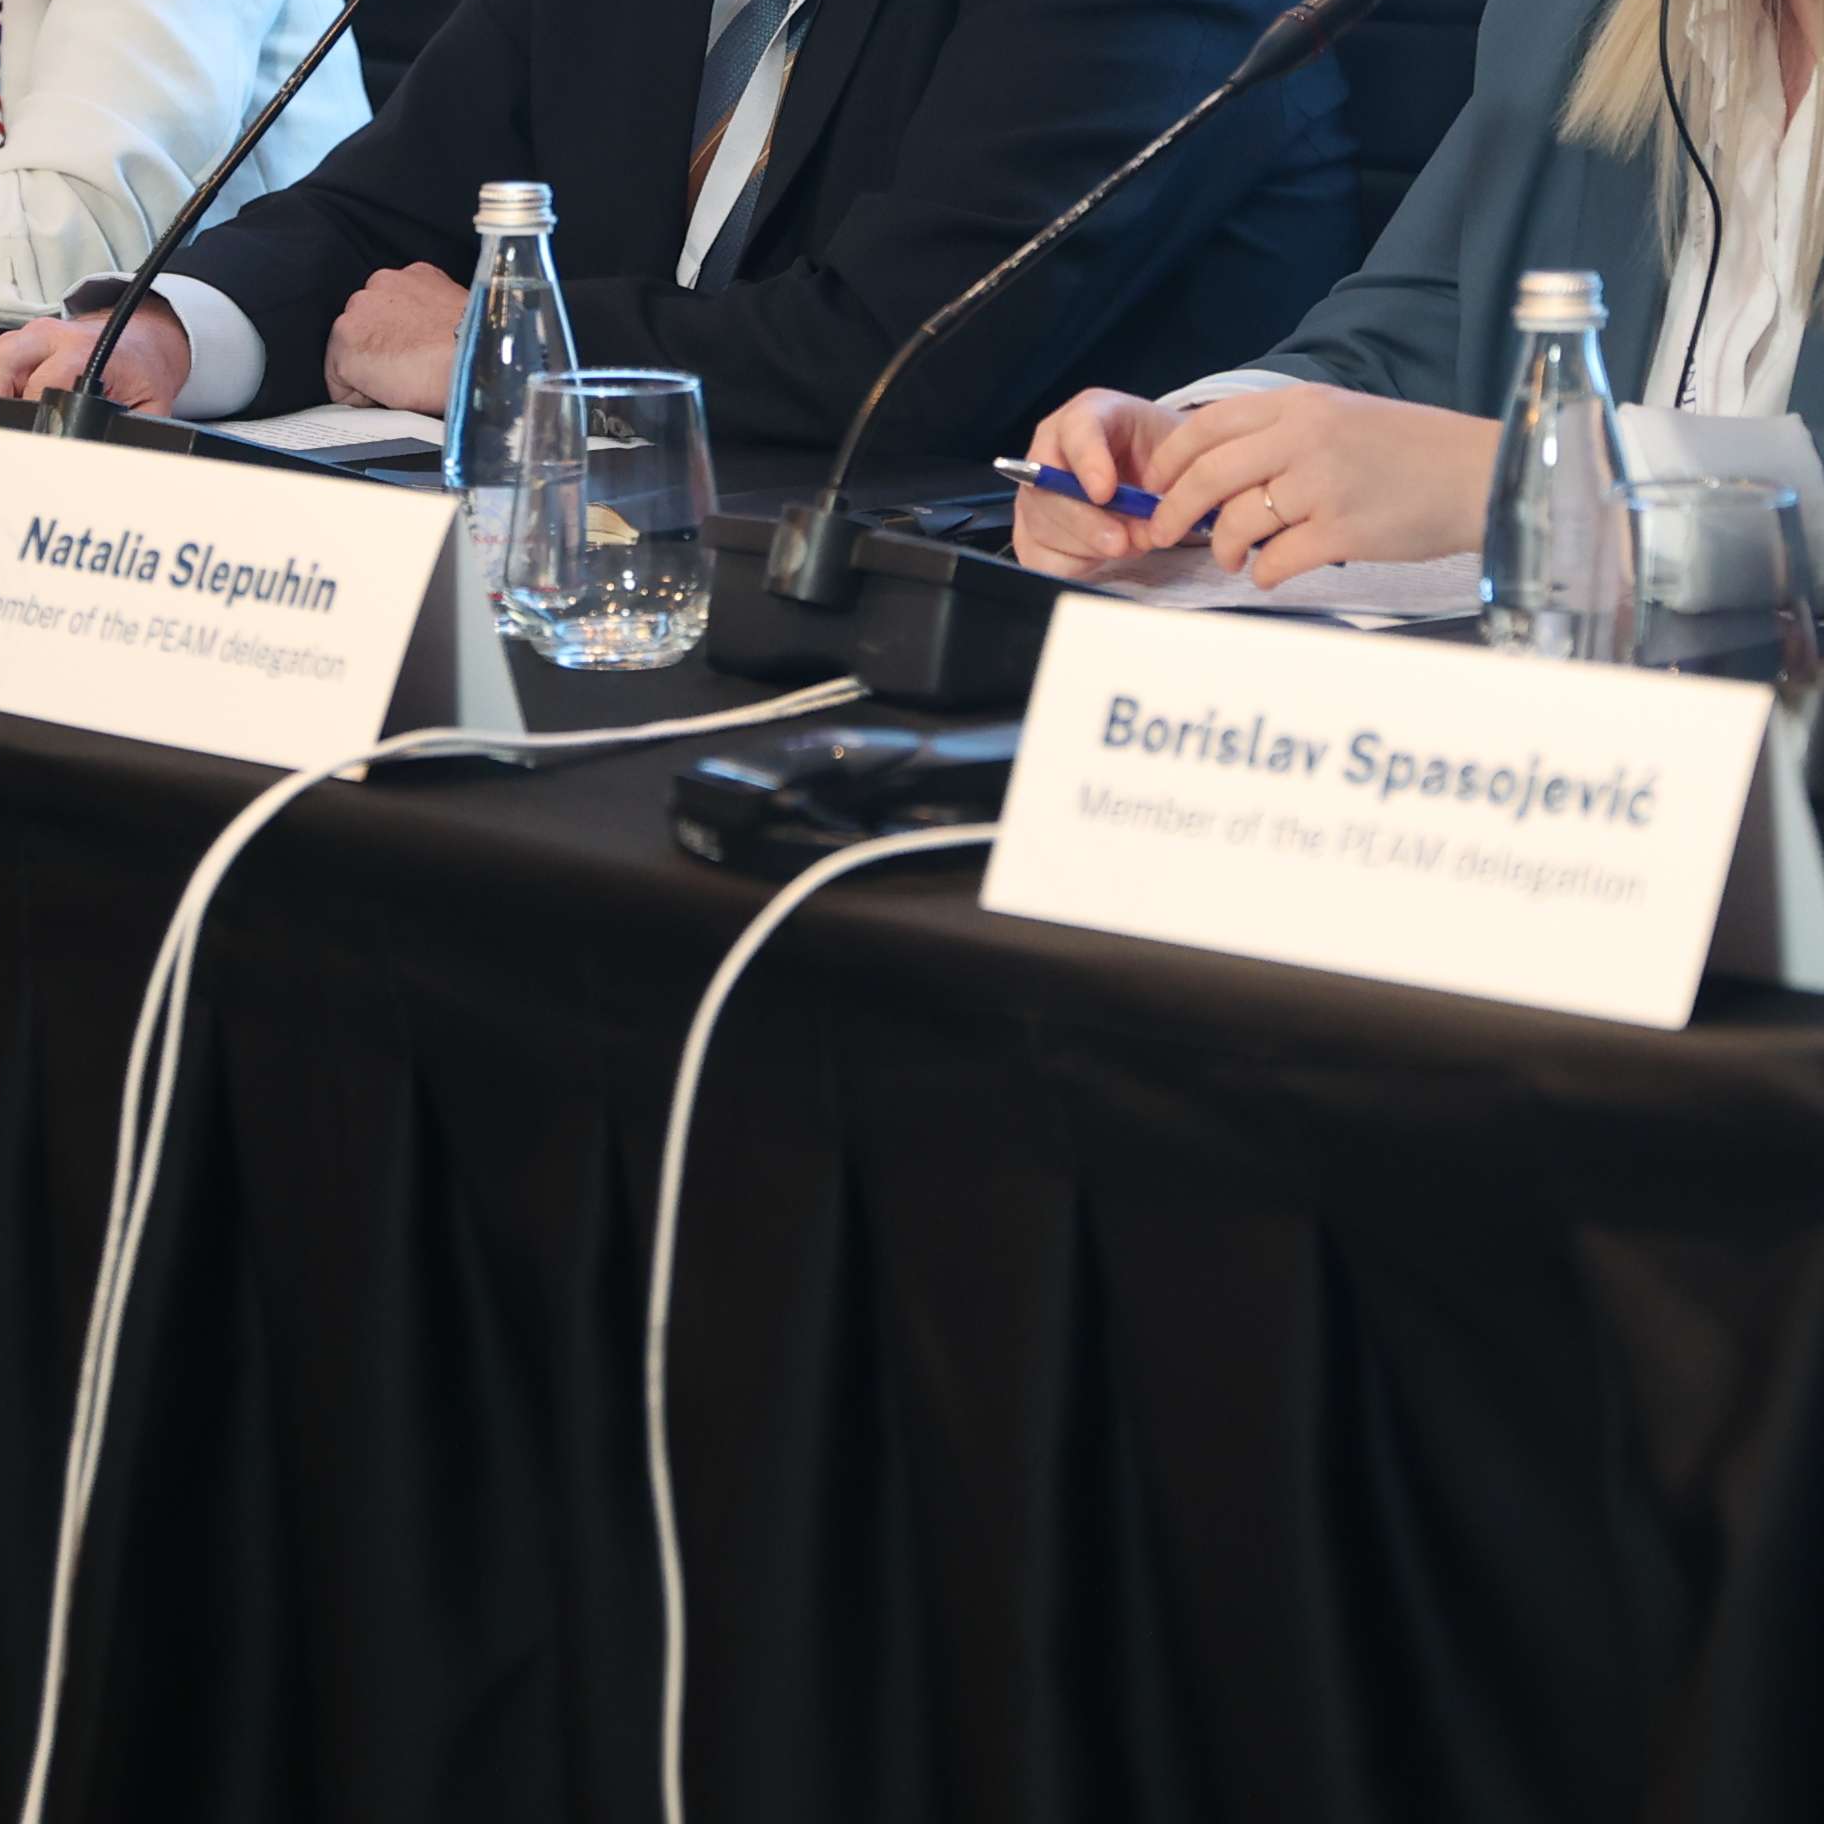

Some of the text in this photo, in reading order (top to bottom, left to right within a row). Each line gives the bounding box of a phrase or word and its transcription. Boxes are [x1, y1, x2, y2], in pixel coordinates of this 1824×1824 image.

[17, 516, 339, 613] Natalia Slepuhin
[68, 606, 100, 636] of
[100, 610, 139, 645] the
[144, 617, 220, 659] PEAM
[219, 631, 346, 683] delegation
[1101, 694, 1660, 828] Borislav Spasojević
[1078, 783, 1215, 838] Member
[1225, 810, 1265, 845] of
[1272, 814, 1325, 854] the
[1455, 844, 1649, 906] delegation
